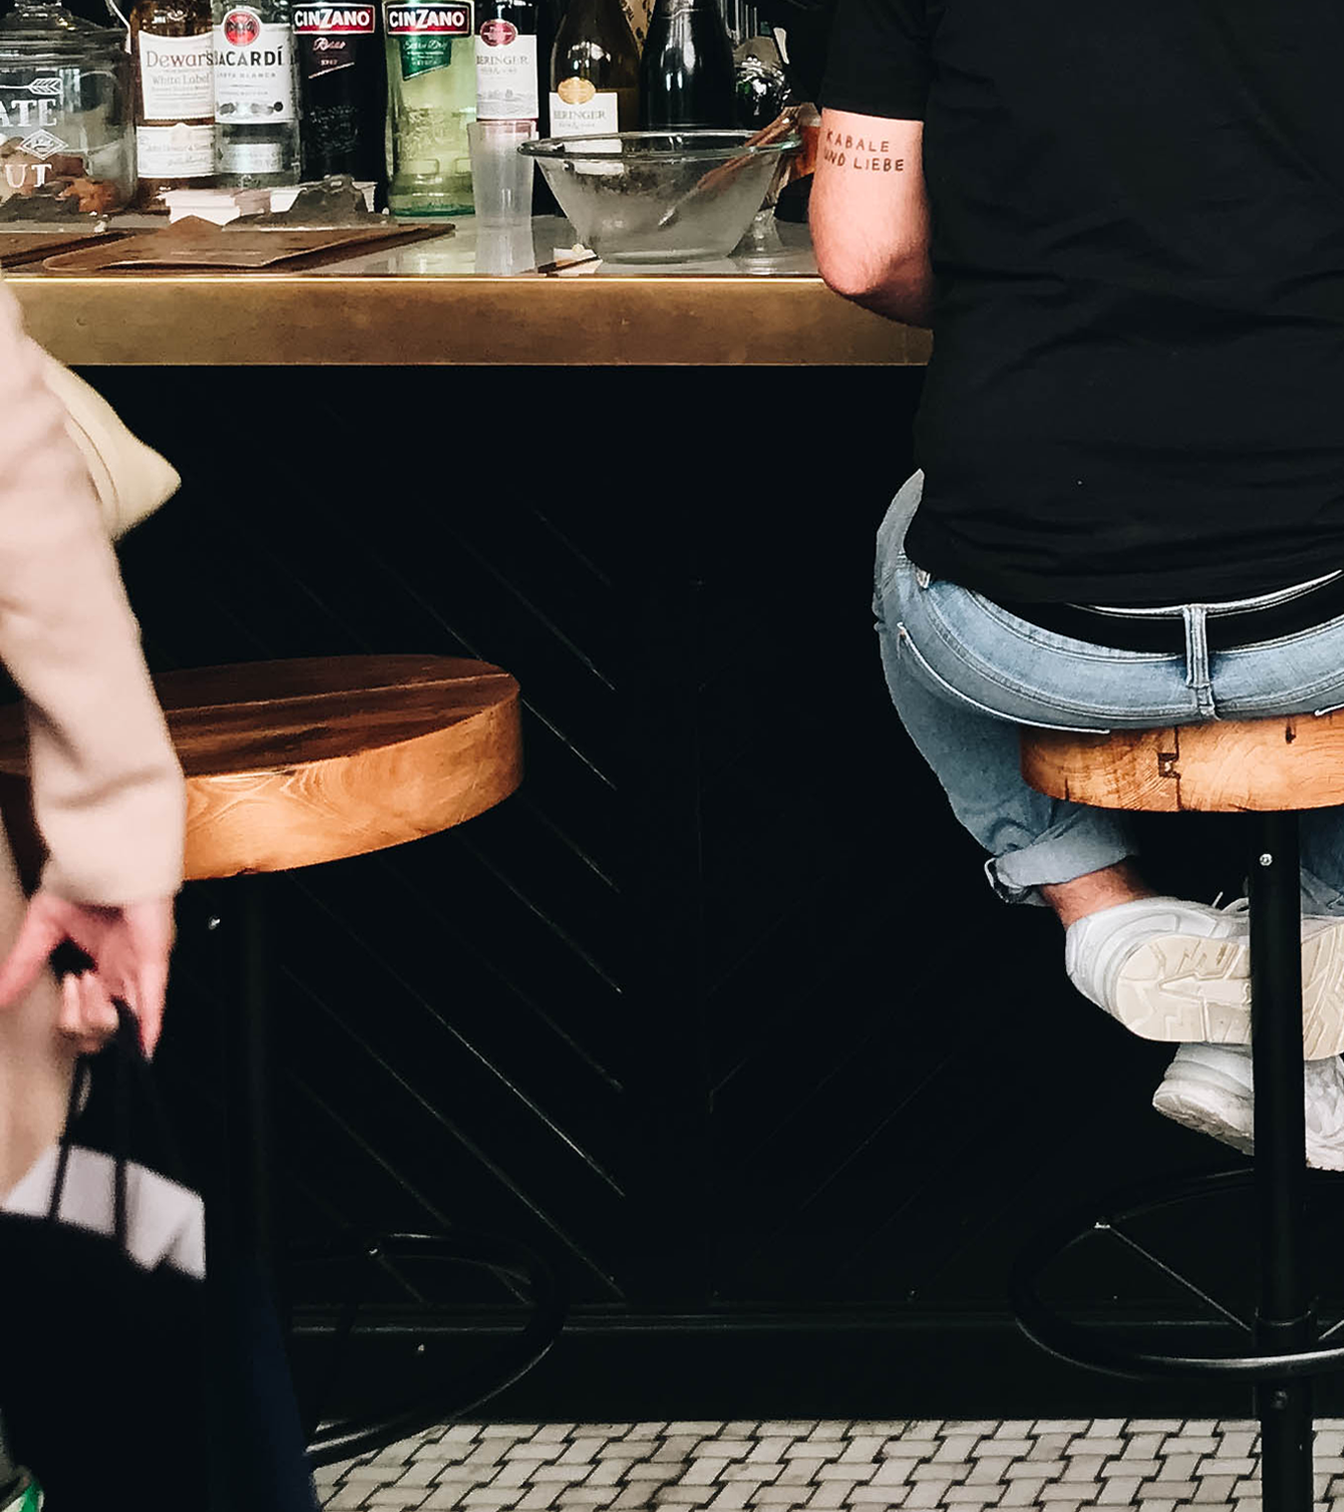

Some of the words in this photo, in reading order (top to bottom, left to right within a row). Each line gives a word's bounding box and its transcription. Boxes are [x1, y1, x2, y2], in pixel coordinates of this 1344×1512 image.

[294, 8, 371, 29] CINZANO
[389, 8, 465, 29] CINZANO
[826, 128, 890, 152] KABALE
[853, 157, 904, 171] LIEBE
